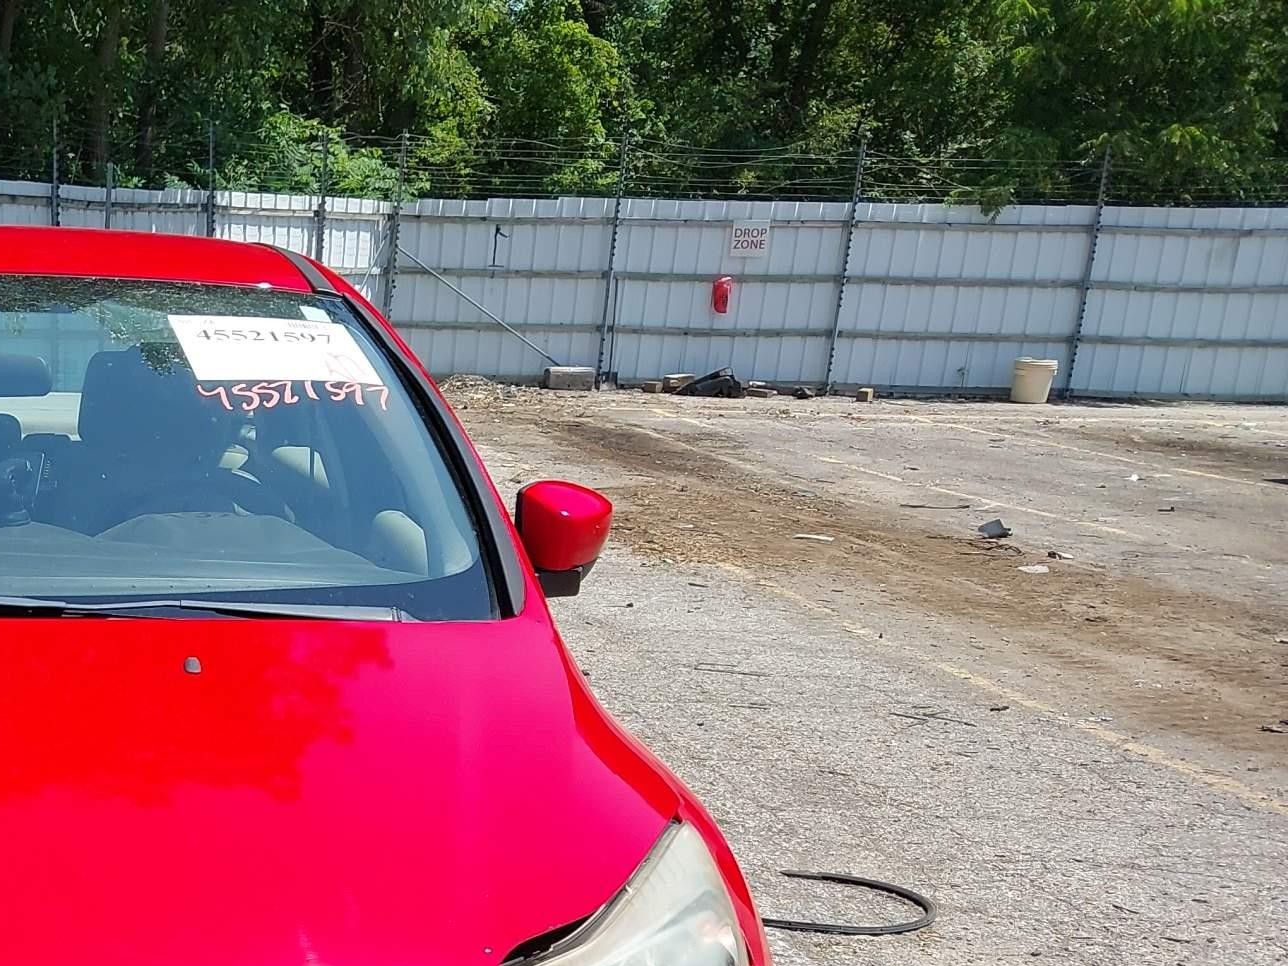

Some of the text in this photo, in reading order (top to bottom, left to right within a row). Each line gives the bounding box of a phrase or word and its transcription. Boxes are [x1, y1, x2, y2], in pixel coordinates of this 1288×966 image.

[734, 228, 768, 239] DROP
[733, 239, 766, 250] ZONE
[197, 329, 331, 345] 45521597
[197, 380, 389, 411] 45521597
